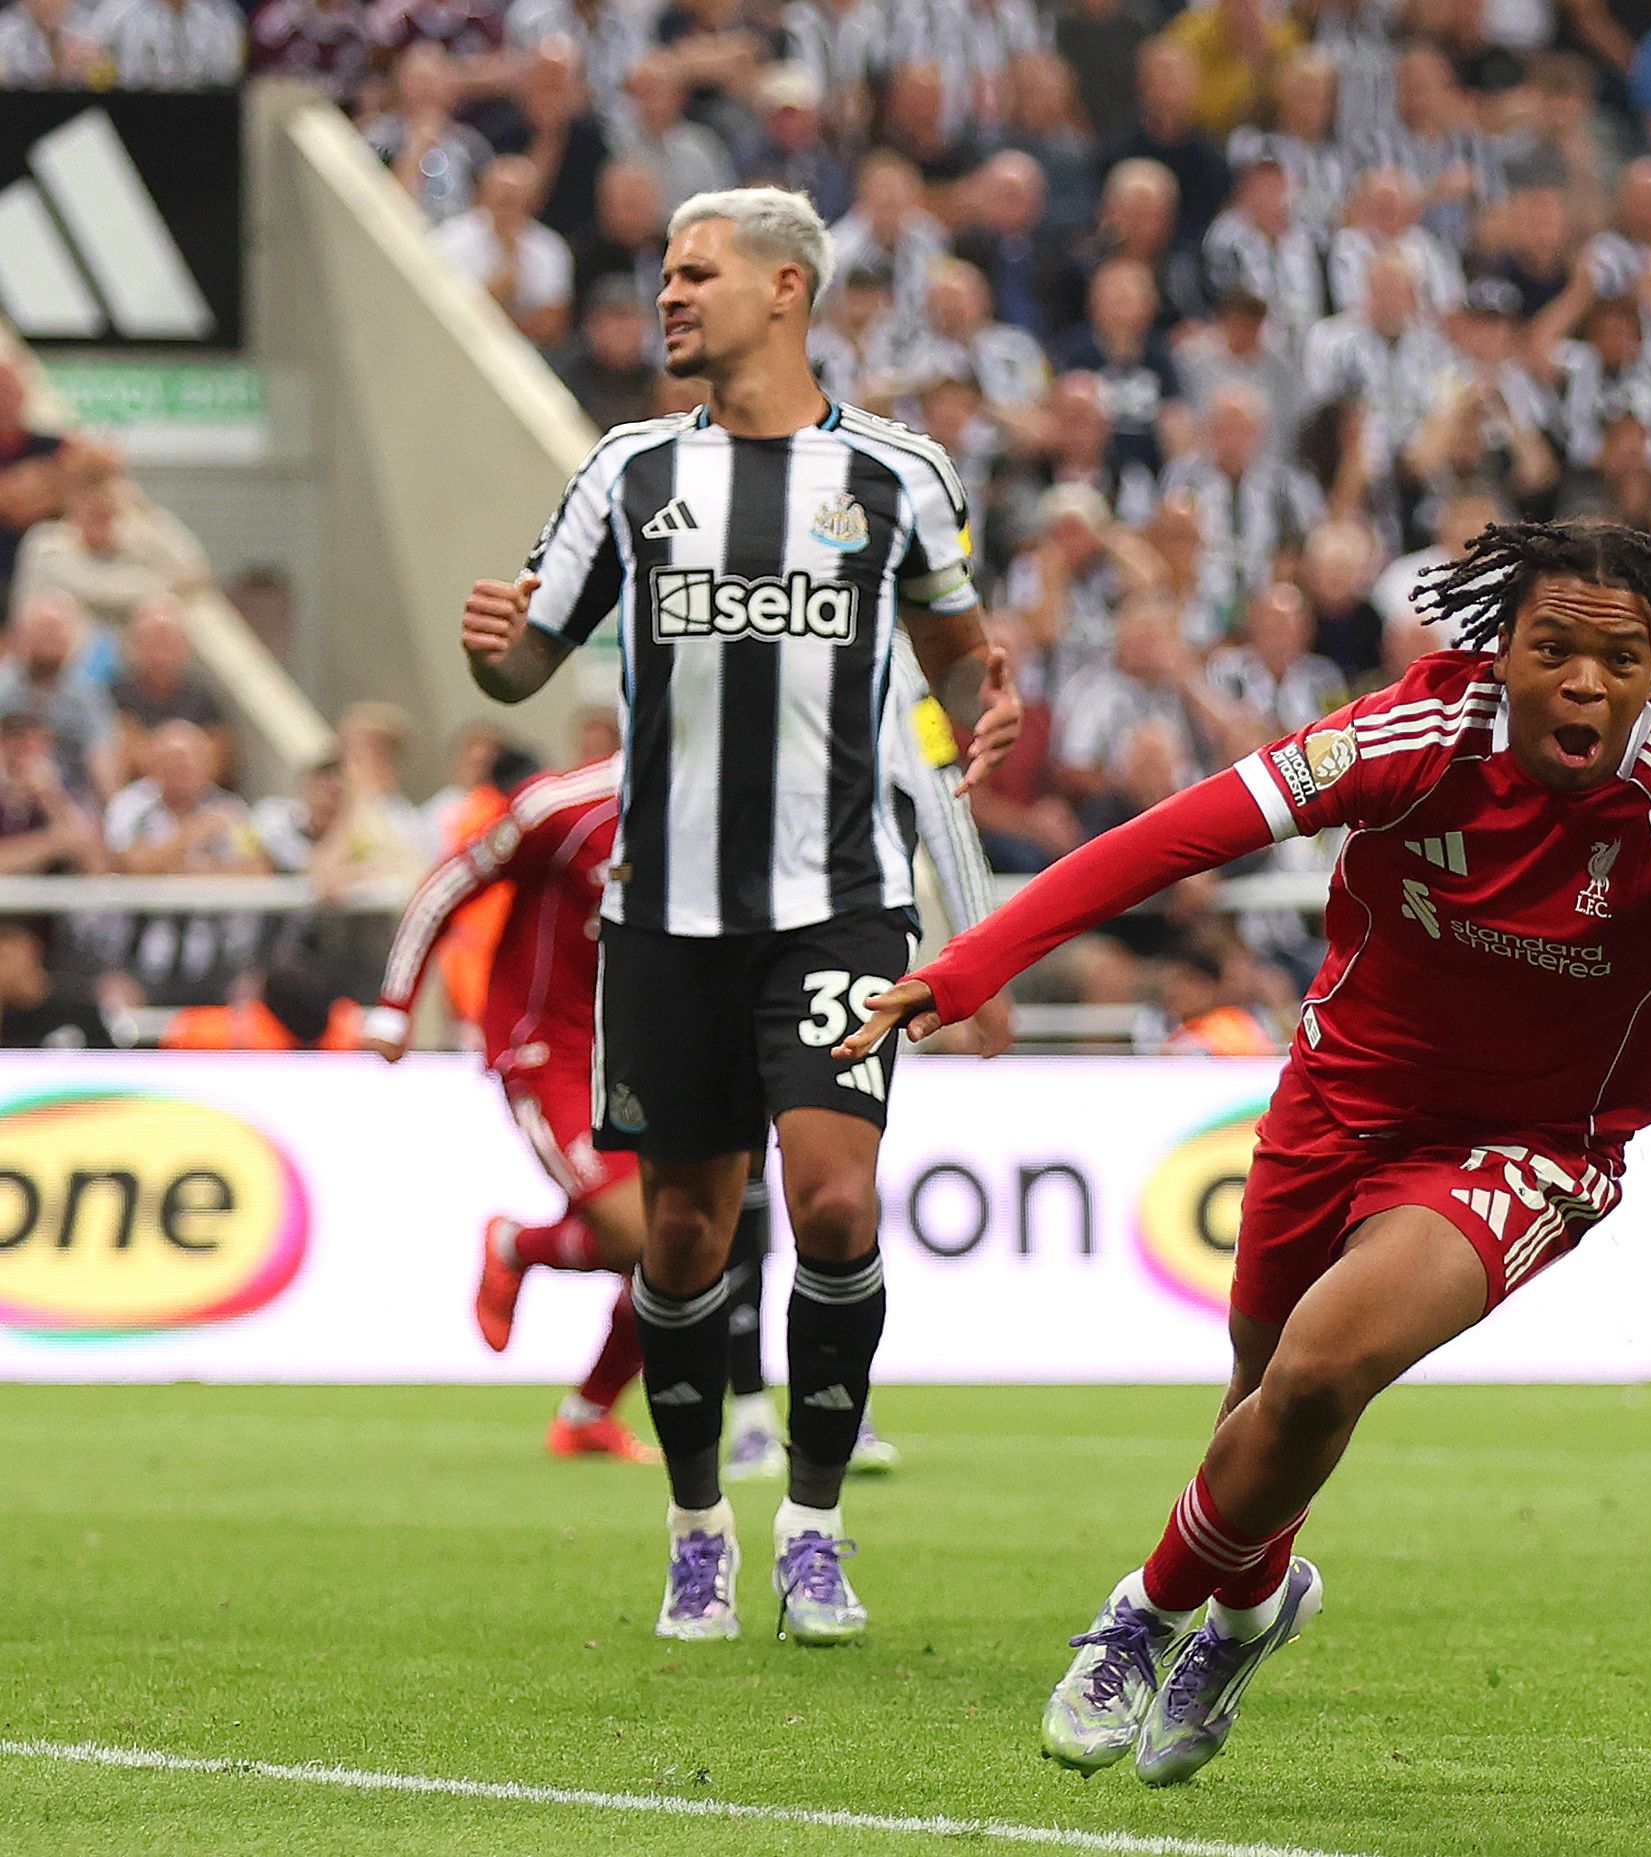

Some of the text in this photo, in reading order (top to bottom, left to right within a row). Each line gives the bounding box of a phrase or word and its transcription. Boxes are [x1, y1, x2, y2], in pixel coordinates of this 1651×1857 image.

[713, 573, 851, 636] sela
[1450, 919, 1603, 962] standard
[1454, 932, 1612, 978] chartered
[875, 1163, 1092, 1258] on
